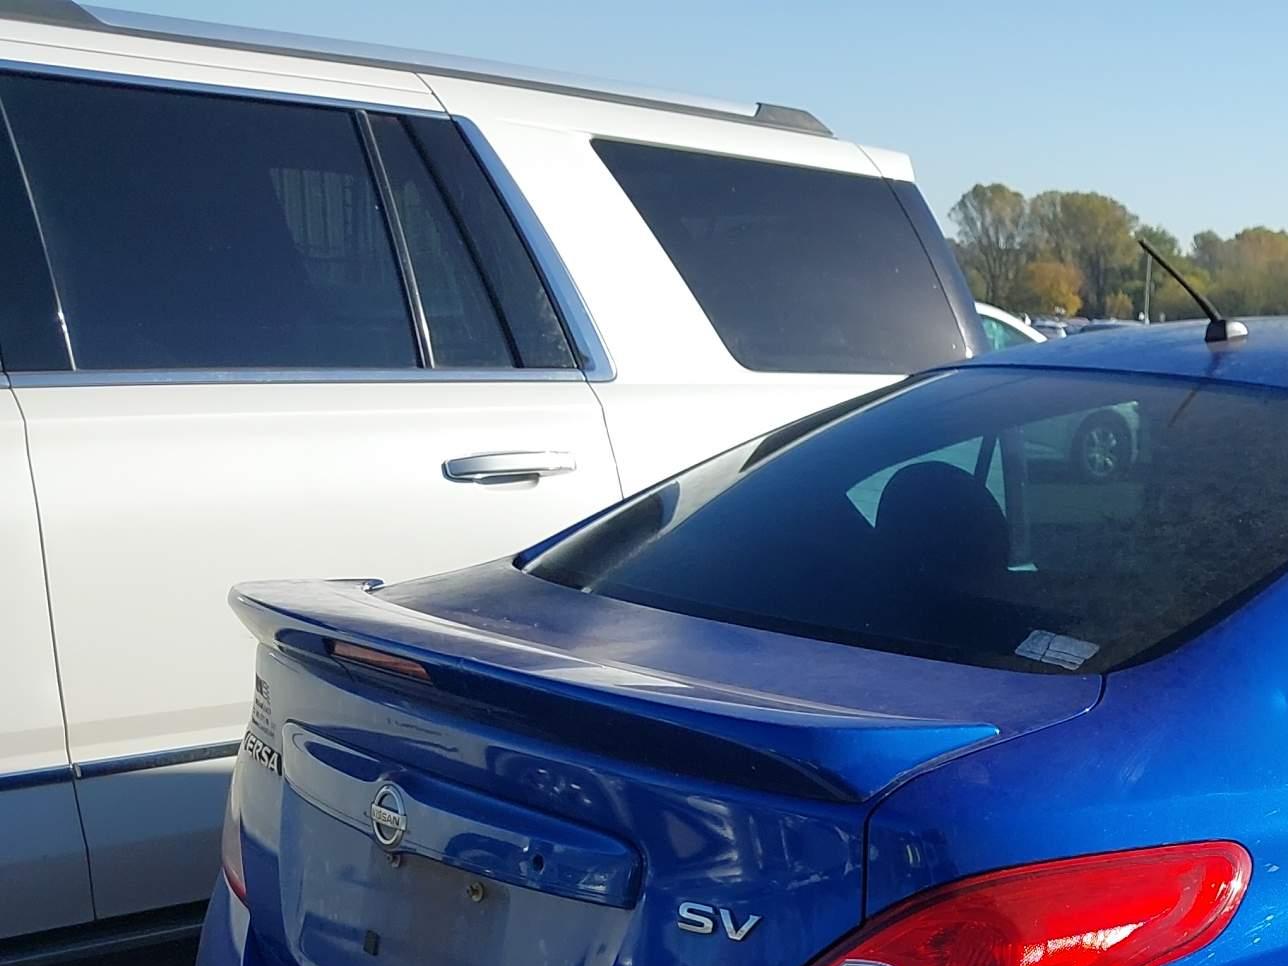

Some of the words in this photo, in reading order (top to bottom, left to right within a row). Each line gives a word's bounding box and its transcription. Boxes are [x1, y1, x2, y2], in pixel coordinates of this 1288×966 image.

[243, 731, 282, 776] VERSA
[372, 806, 400, 826] NISSAN
[677, 902, 762, 940] SV
